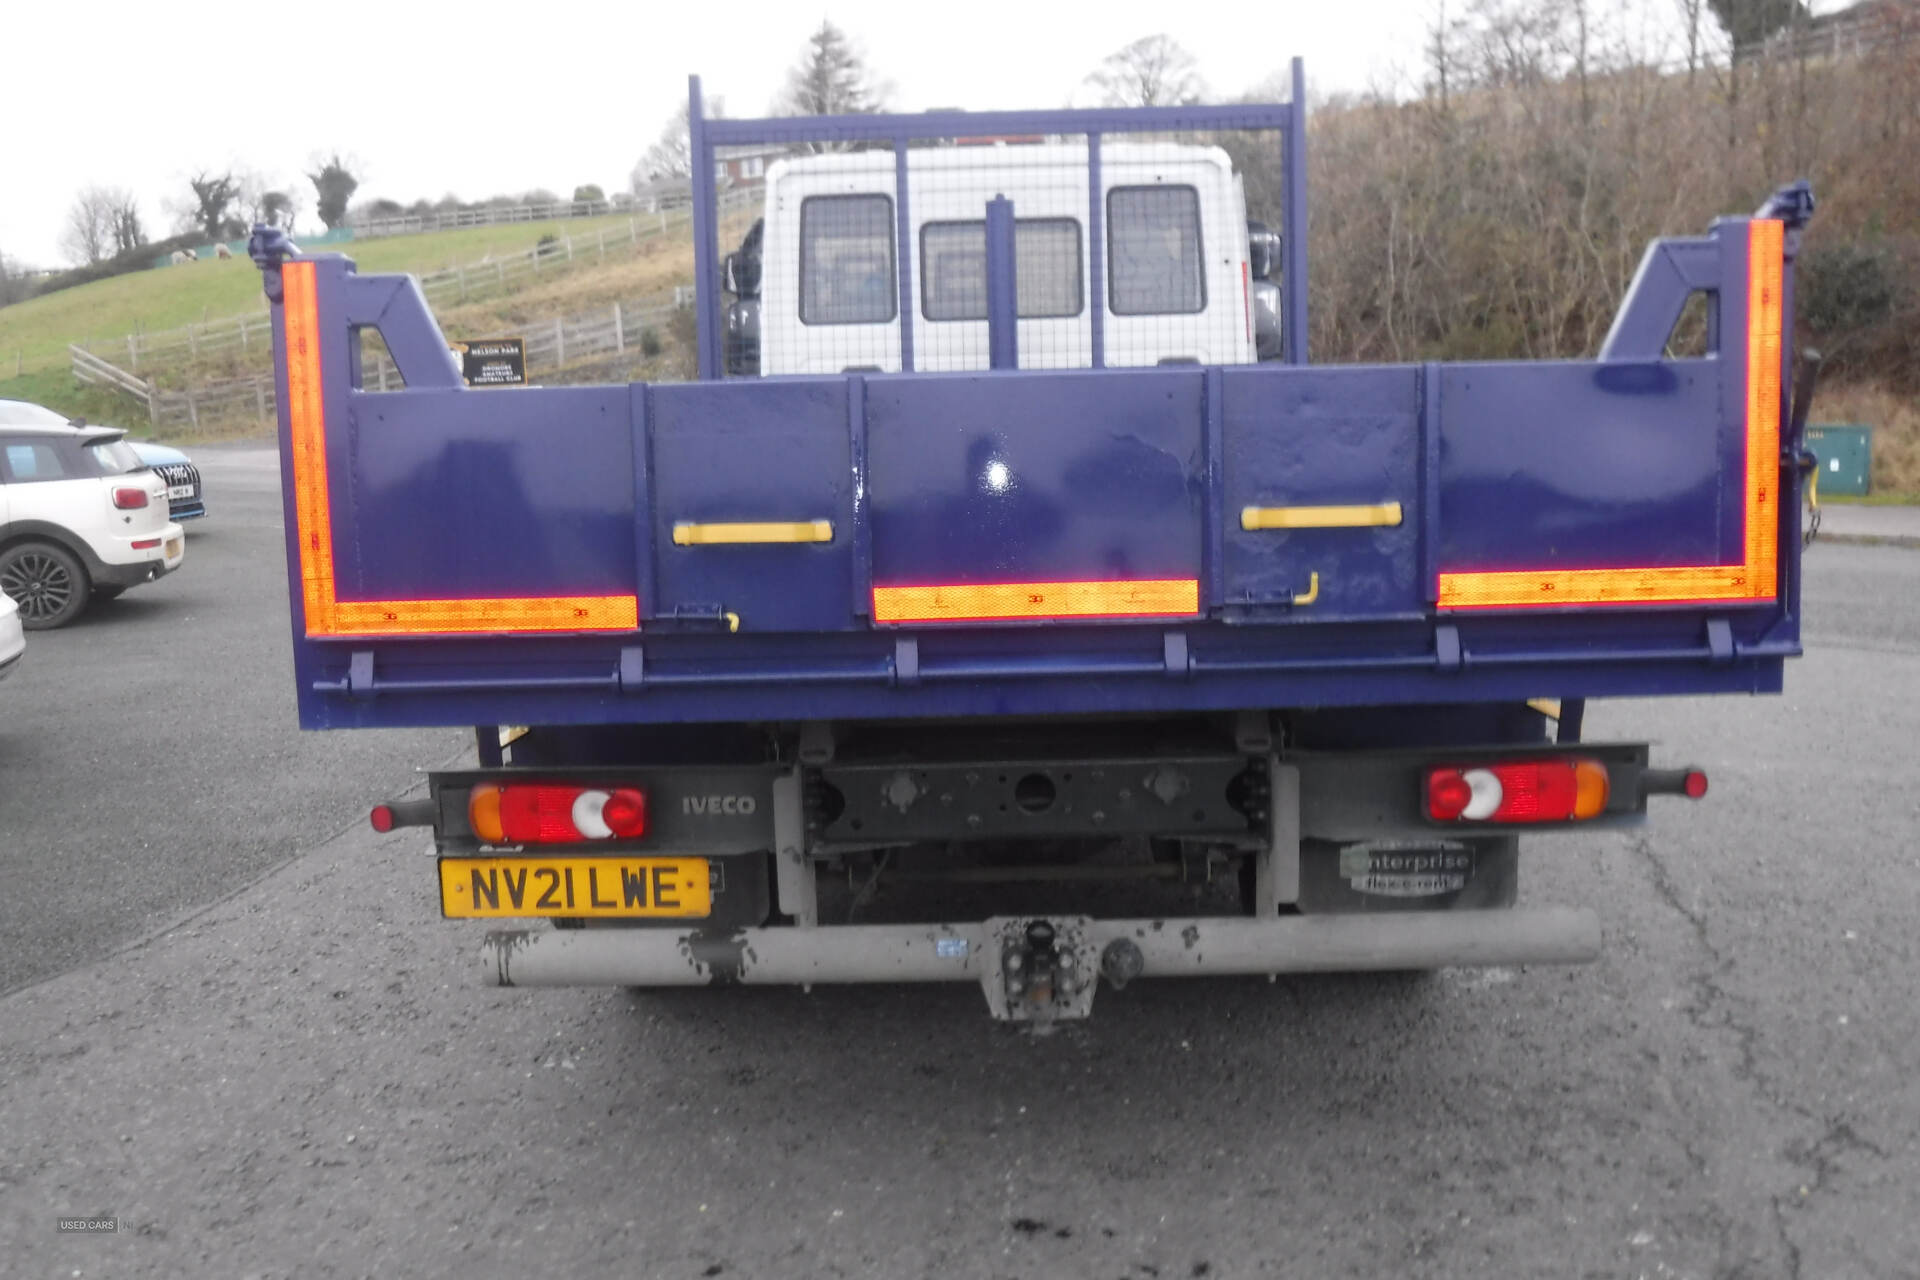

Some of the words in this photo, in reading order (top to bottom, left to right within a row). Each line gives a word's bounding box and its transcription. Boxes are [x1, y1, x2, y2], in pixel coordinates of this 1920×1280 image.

[682, 795, 756, 814] IVECO
[1346, 853, 1469, 873] nterprise
[588, 866, 681, 909] LWE
